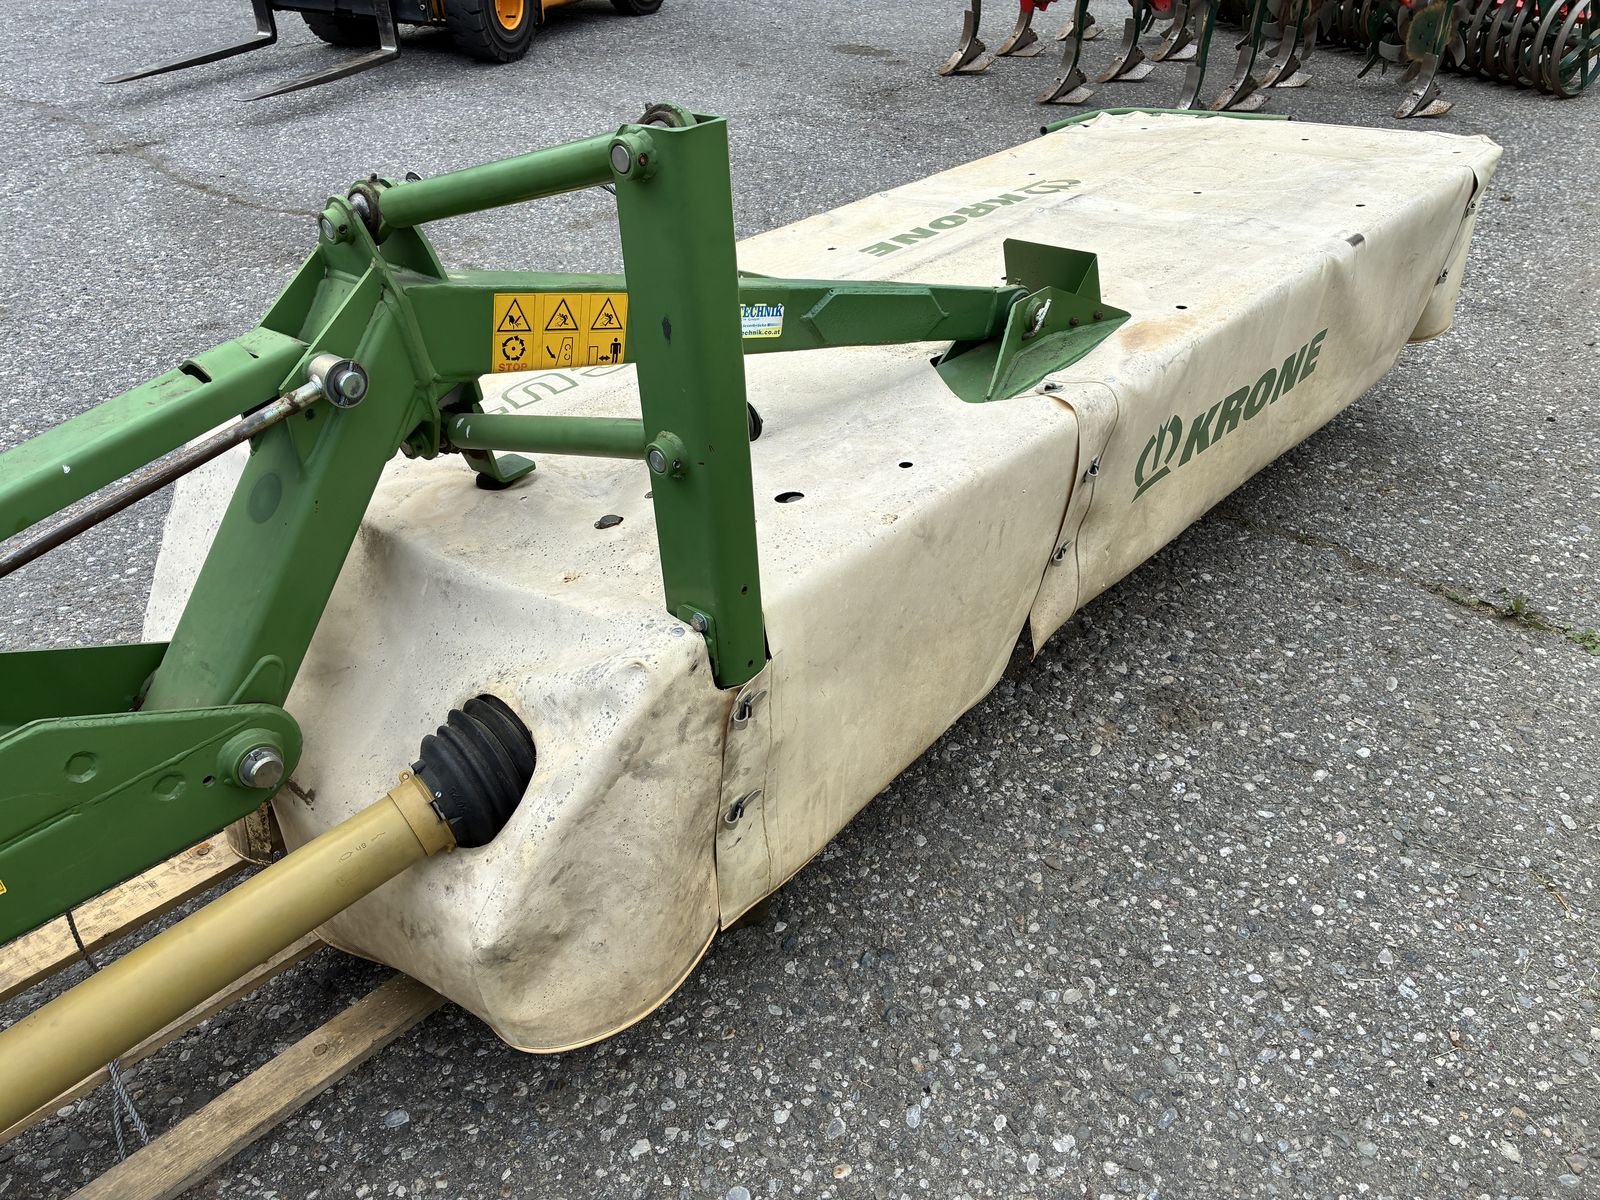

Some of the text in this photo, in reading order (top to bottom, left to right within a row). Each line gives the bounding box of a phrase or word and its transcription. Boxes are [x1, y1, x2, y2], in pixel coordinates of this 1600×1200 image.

[858, 193, 1028, 257] KRONE
[741, 305, 783, 317] ECHNIK
[498, 363, 528, 372] STOP
[1178, 327, 1328, 467] KRONE
